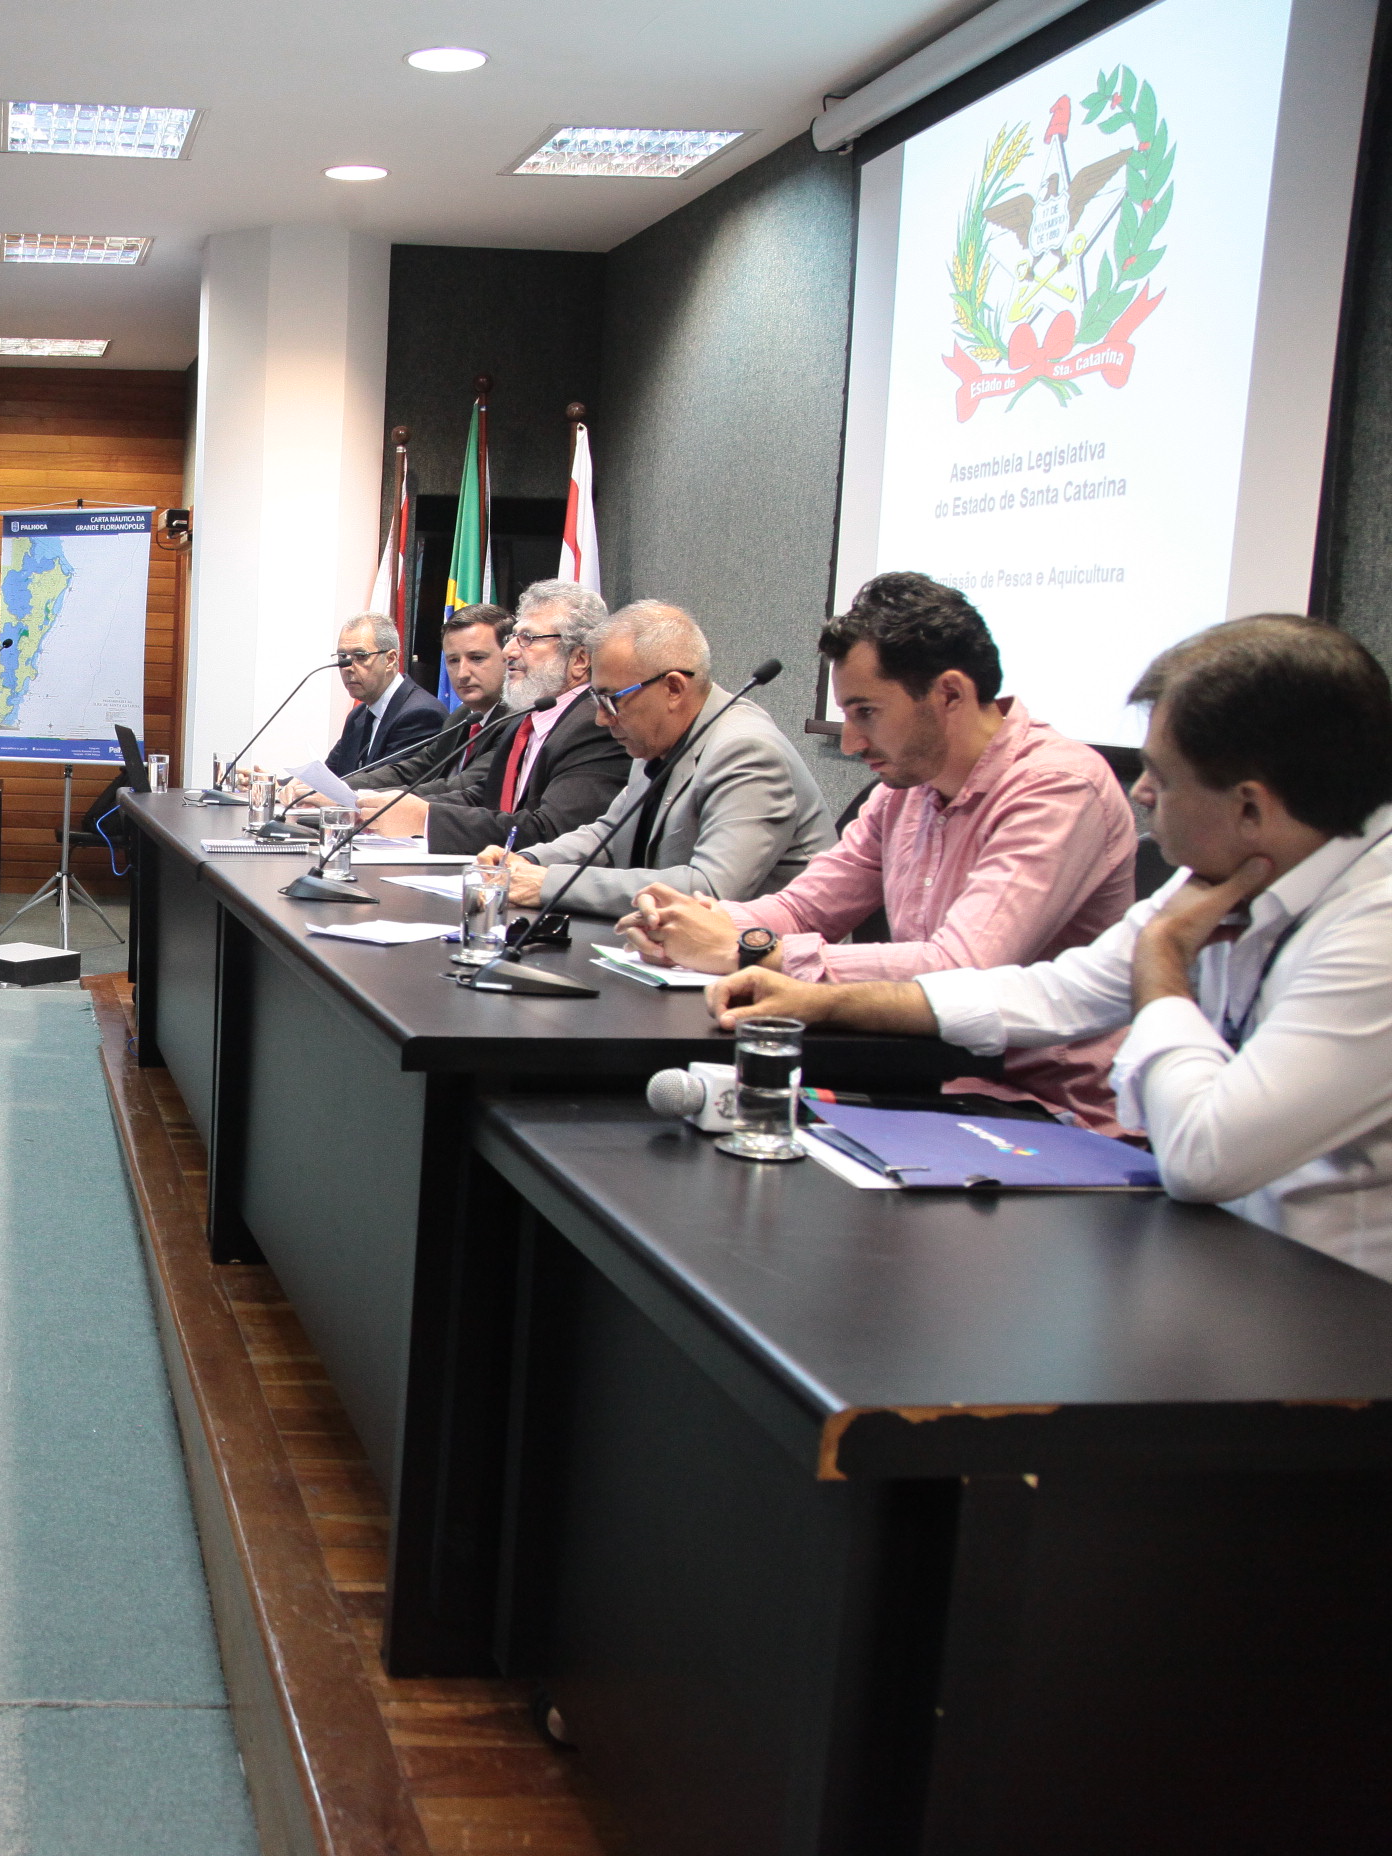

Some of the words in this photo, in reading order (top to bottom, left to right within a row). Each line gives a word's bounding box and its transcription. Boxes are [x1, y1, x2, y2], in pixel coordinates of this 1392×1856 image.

[1053, 364, 1072, 376] Sta.
[1075, 348, 1125, 371] Catarina
[970, 378, 1002, 398] Estado
[1004, 378, 1016, 389] de
[950, 453, 1023, 483] Assembleia
[1027, 440, 1106, 474] Legislativa
[935, 500, 949, 519] do
[952, 493, 996, 517] Estado
[999, 490, 1016, 511] de
[1019, 484, 1059, 508] Santa
[1064, 476, 1127, 502] Catarina
[100, 523, 145, 531] FLORIANÓPOLIS
[110, 514, 135, 523] NÁUTICA
[930, 571, 977, 590] omissão
[981, 571, 994, 588] de
[997, 569, 1032, 587] Pesca
[1036, 572, 1044, 586] e
[1048, 563, 1125, 589] Aquicultura
